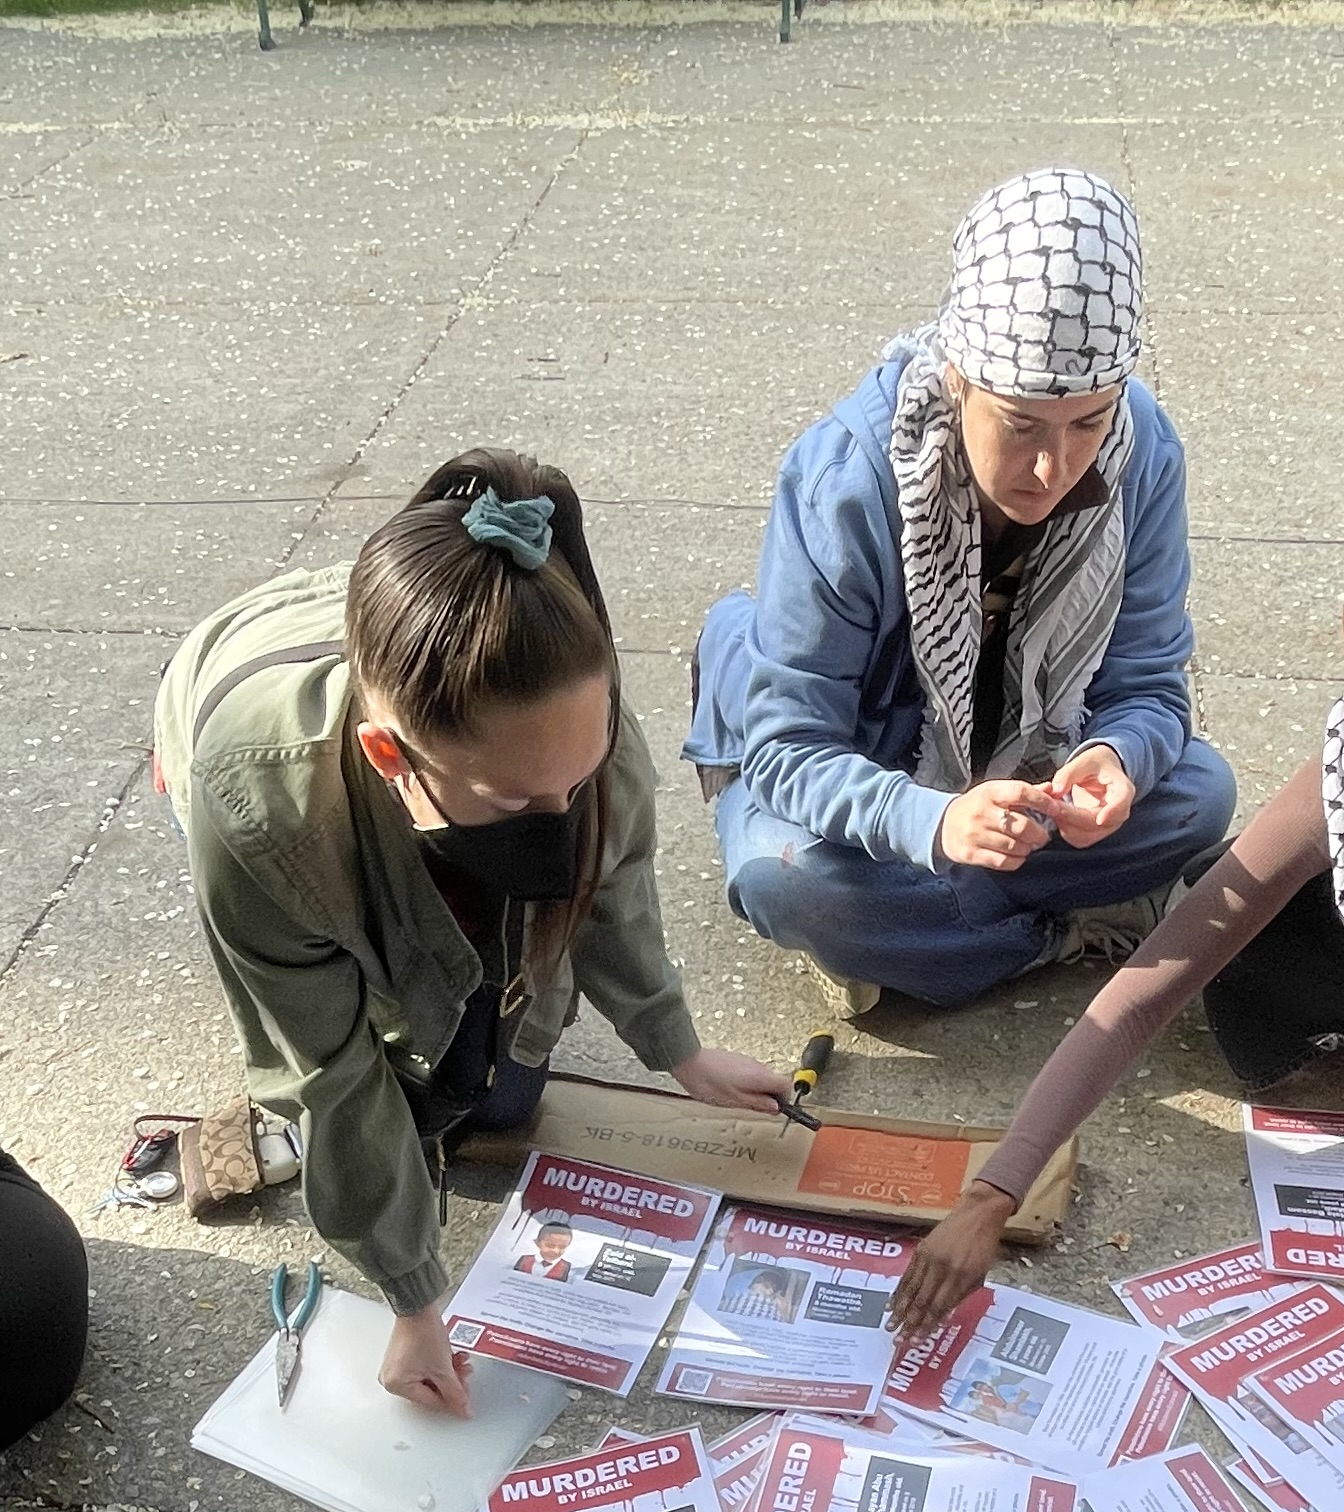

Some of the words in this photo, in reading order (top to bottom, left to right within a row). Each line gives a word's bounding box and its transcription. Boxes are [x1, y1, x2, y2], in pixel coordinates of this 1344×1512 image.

[543, 1168, 698, 1218] MURDERED
[581, 1196, 599, 1208] BY
[600, 1202, 642, 1218] ISRAEL
[852, 1181, 911, 1202] STOP
[741, 1218, 903, 1257] MURDERED
[785, 1242, 804, 1251] BY
[806, 1245, 851, 1260] ISRAEL
[1197, 1285, 1215, 1296] BY
[1217, 1273, 1262, 1290] ISRAEL
[928, 1355, 943, 1370] BY
[938, 1324, 962, 1356] ISRAEL
[1190, 1298, 1329, 1372] MURDERED
[1246, 1348, 1264, 1362] BY
[1263, 1330, 1305, 1353] ISRAEL
[501, 1446, 680, 1502] MURDERED
[558, 1492, 577, 1504] BY
[581, 1479, 633, 1499] ISRAEL
